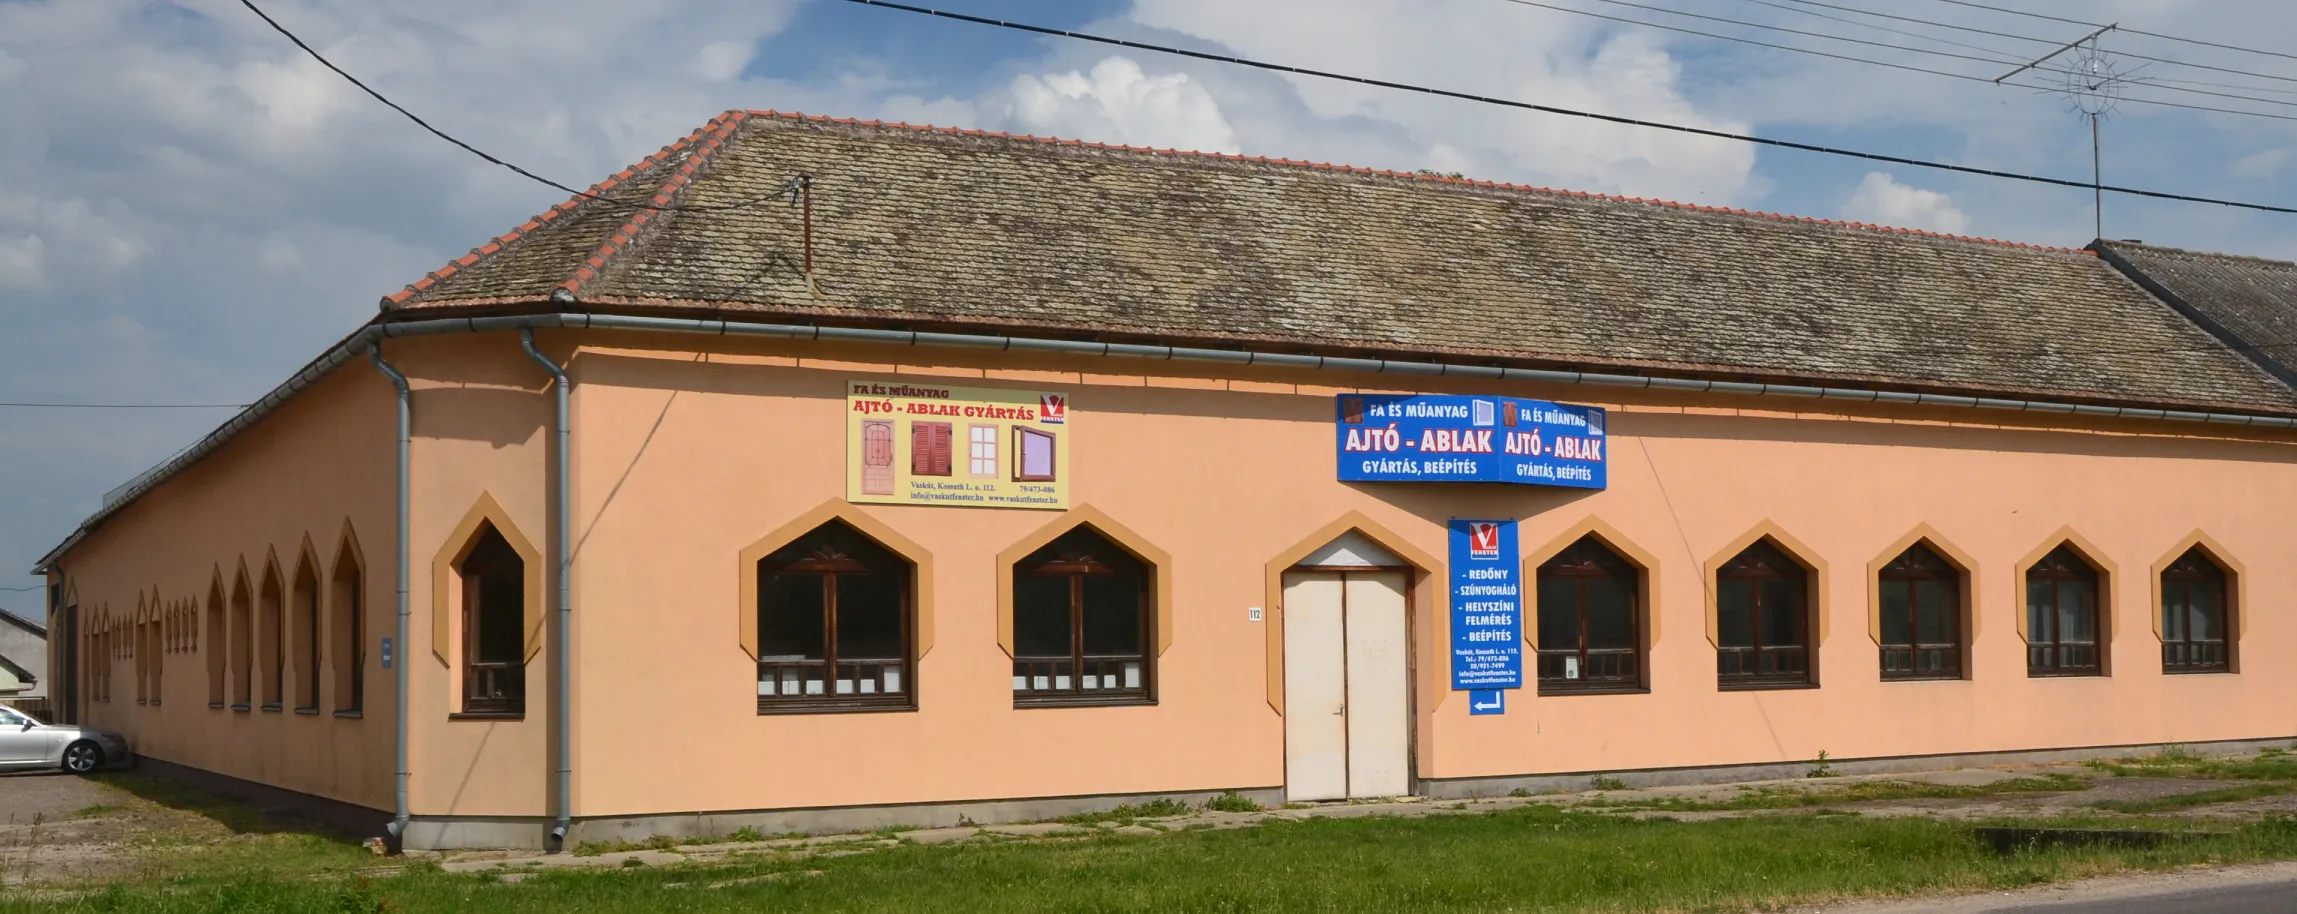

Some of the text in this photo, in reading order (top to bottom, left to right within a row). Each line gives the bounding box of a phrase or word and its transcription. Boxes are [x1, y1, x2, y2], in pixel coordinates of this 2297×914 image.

[853, 383, 949, 399] FA ÉS MŰANYAG
[853, 399, 893, 415] AJTÓ
[906, 403, 961, 416] ABLAK
[964, 404, 1034, 420] GYÁRTÁS
[1370, 401, 1468, 418] FA ÉS MŰANYAG
[1521, 407, 1586, 427] FA ÉS MŰANYAG
[1345, 423, 1494, 453] AJTÓ - ABLAK
[1504, 428, 1541, 456] AJTÓ
[1554, 436, 1602, 462] ABLAK
[1362, 458, 1477, 476] GYÁRTÁS, BEÉPÍTÉS
[1516, 461, 1592, 481] GYÁRTÁS, BEÉPÍTÉS
[911, 481, 936, 490] Vaskút,
[938, 483, 964, 491] Kossuth
[983, 484, 996, 492] 112.
[1020, 485, 1055, 493] 79/473-086
[911, 492, 1058, 504] info@vaskutfenster.hu www.vaskutfenster.hu
[1469, 567, 1509, 580] REDŐNY
[1249, 609, 1261, 619] 112
[1465, 600, 1515, 612] HELYSZÍNI
[1465, 613, 1512, 626] FELMÉRÉS
[1469, 629, 1512, 642] BEÉPÍTÉS
